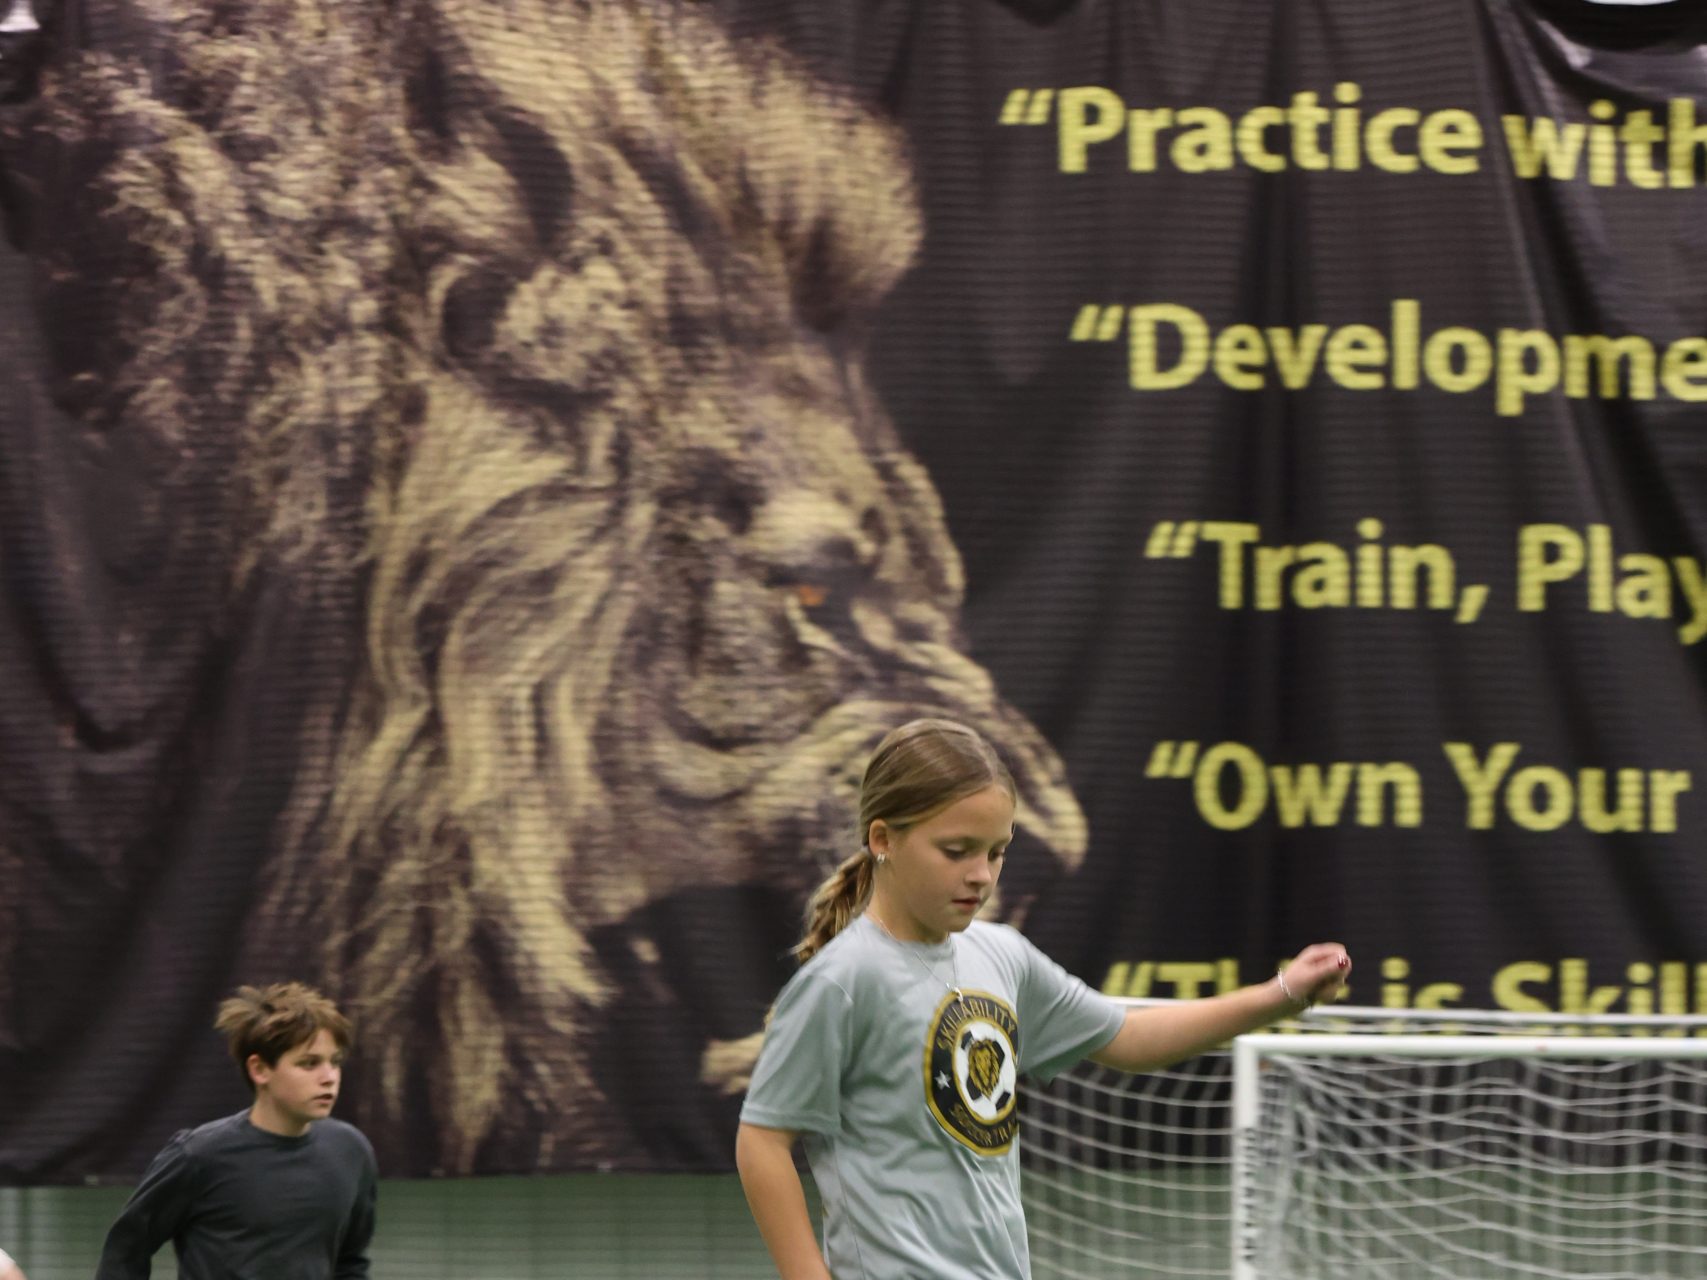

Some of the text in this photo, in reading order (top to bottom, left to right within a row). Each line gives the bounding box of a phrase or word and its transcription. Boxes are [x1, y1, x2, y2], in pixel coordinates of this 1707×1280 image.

[999, 82, 1707, 188] “Practice with
[1071, 299, 1707, 416] “Developme
[1144, 518, 1707, 645] “Train, Play
[1145, 740, 1691, 832] “Own Your
